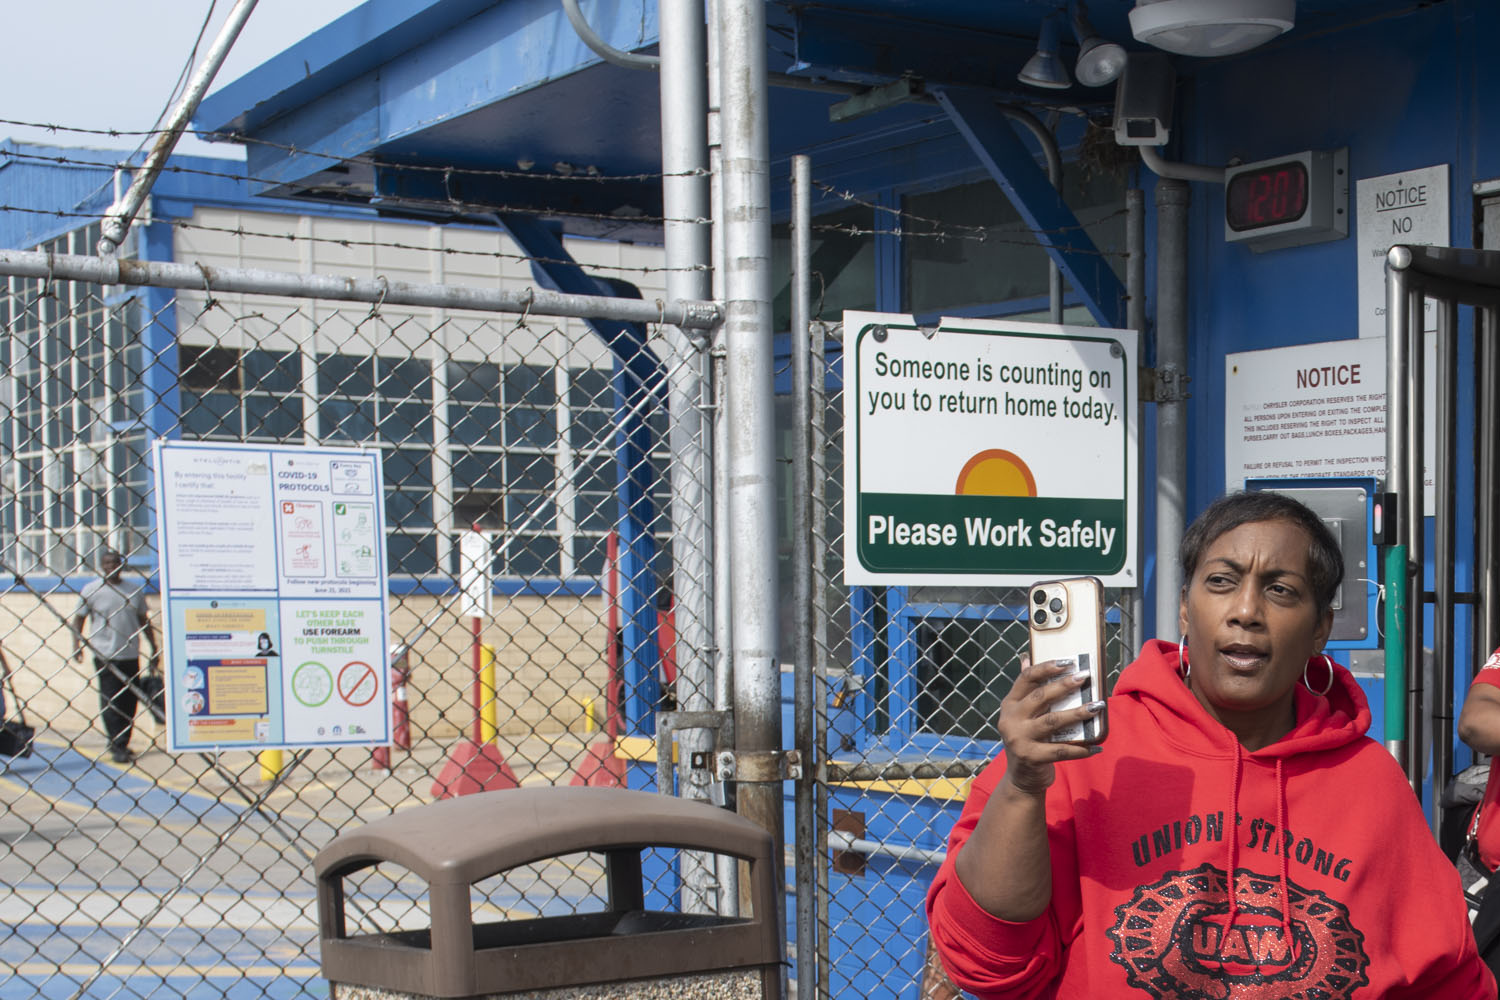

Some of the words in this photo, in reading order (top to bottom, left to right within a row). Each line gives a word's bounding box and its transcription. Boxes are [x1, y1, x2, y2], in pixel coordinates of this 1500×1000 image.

[1376, 185, 1427, 209] NOTICE
[1392, 217, 1412, 235] NO
[875, 352, 970, 381] Someone
[977, 358, 993, 382] is
[1000, 363, 1082, 393] counting
[1089, 369, 1111, 389] on
[1297, 363, 1361, 389] NOTICE
[868, 391, 906, 415] you
[913, 388, 932, 411] to
[939, 391, 998, 415] return
[1005, 391, 1057, 417] home
[1064, 396, 1118, 425] today.
[1263, 401, 1288, 409] CHRYSLER
[1289, 398, 1325, 407] CORPORATION
[1327, 396, 1354, 404] RESERVES
[1292, 410, 1317, 418] ENTERING
[1328, 408, 1349, 416] EXITING
[1281, 421, 1308, 430] RESERVING
[1336, 456, 1369, 464] INSPECTION
[278, 471, 317, 479] COVID-19
[279, 483, 330, 492] PROTOCOLS
[868, 515, 957, 545] Please
[964, 517, 1032, 547] Work
[1039, 519, 1116, 555] Safely
[320, 610, 340, 618] KEEP
[343, 610, 364, 618] EACH
[307, 619, 333, 627] OTHER
[335, 619, 356, 627] SAFE
[303, 628, 318, 636] USE
[320, 628, 361, 636] FOREARM
[294, 637, 304, 645] TO
[306, 637, 329, 645] PUSH
[331, 637, 369, 645] THROUGH
[311, 646, 354, 654] TURNSTILE
[1131, 811, 1224, 867] UNION
[1247, 818, 1353, 882] STRONG
[1193, 924, 1290, 961] UAW
